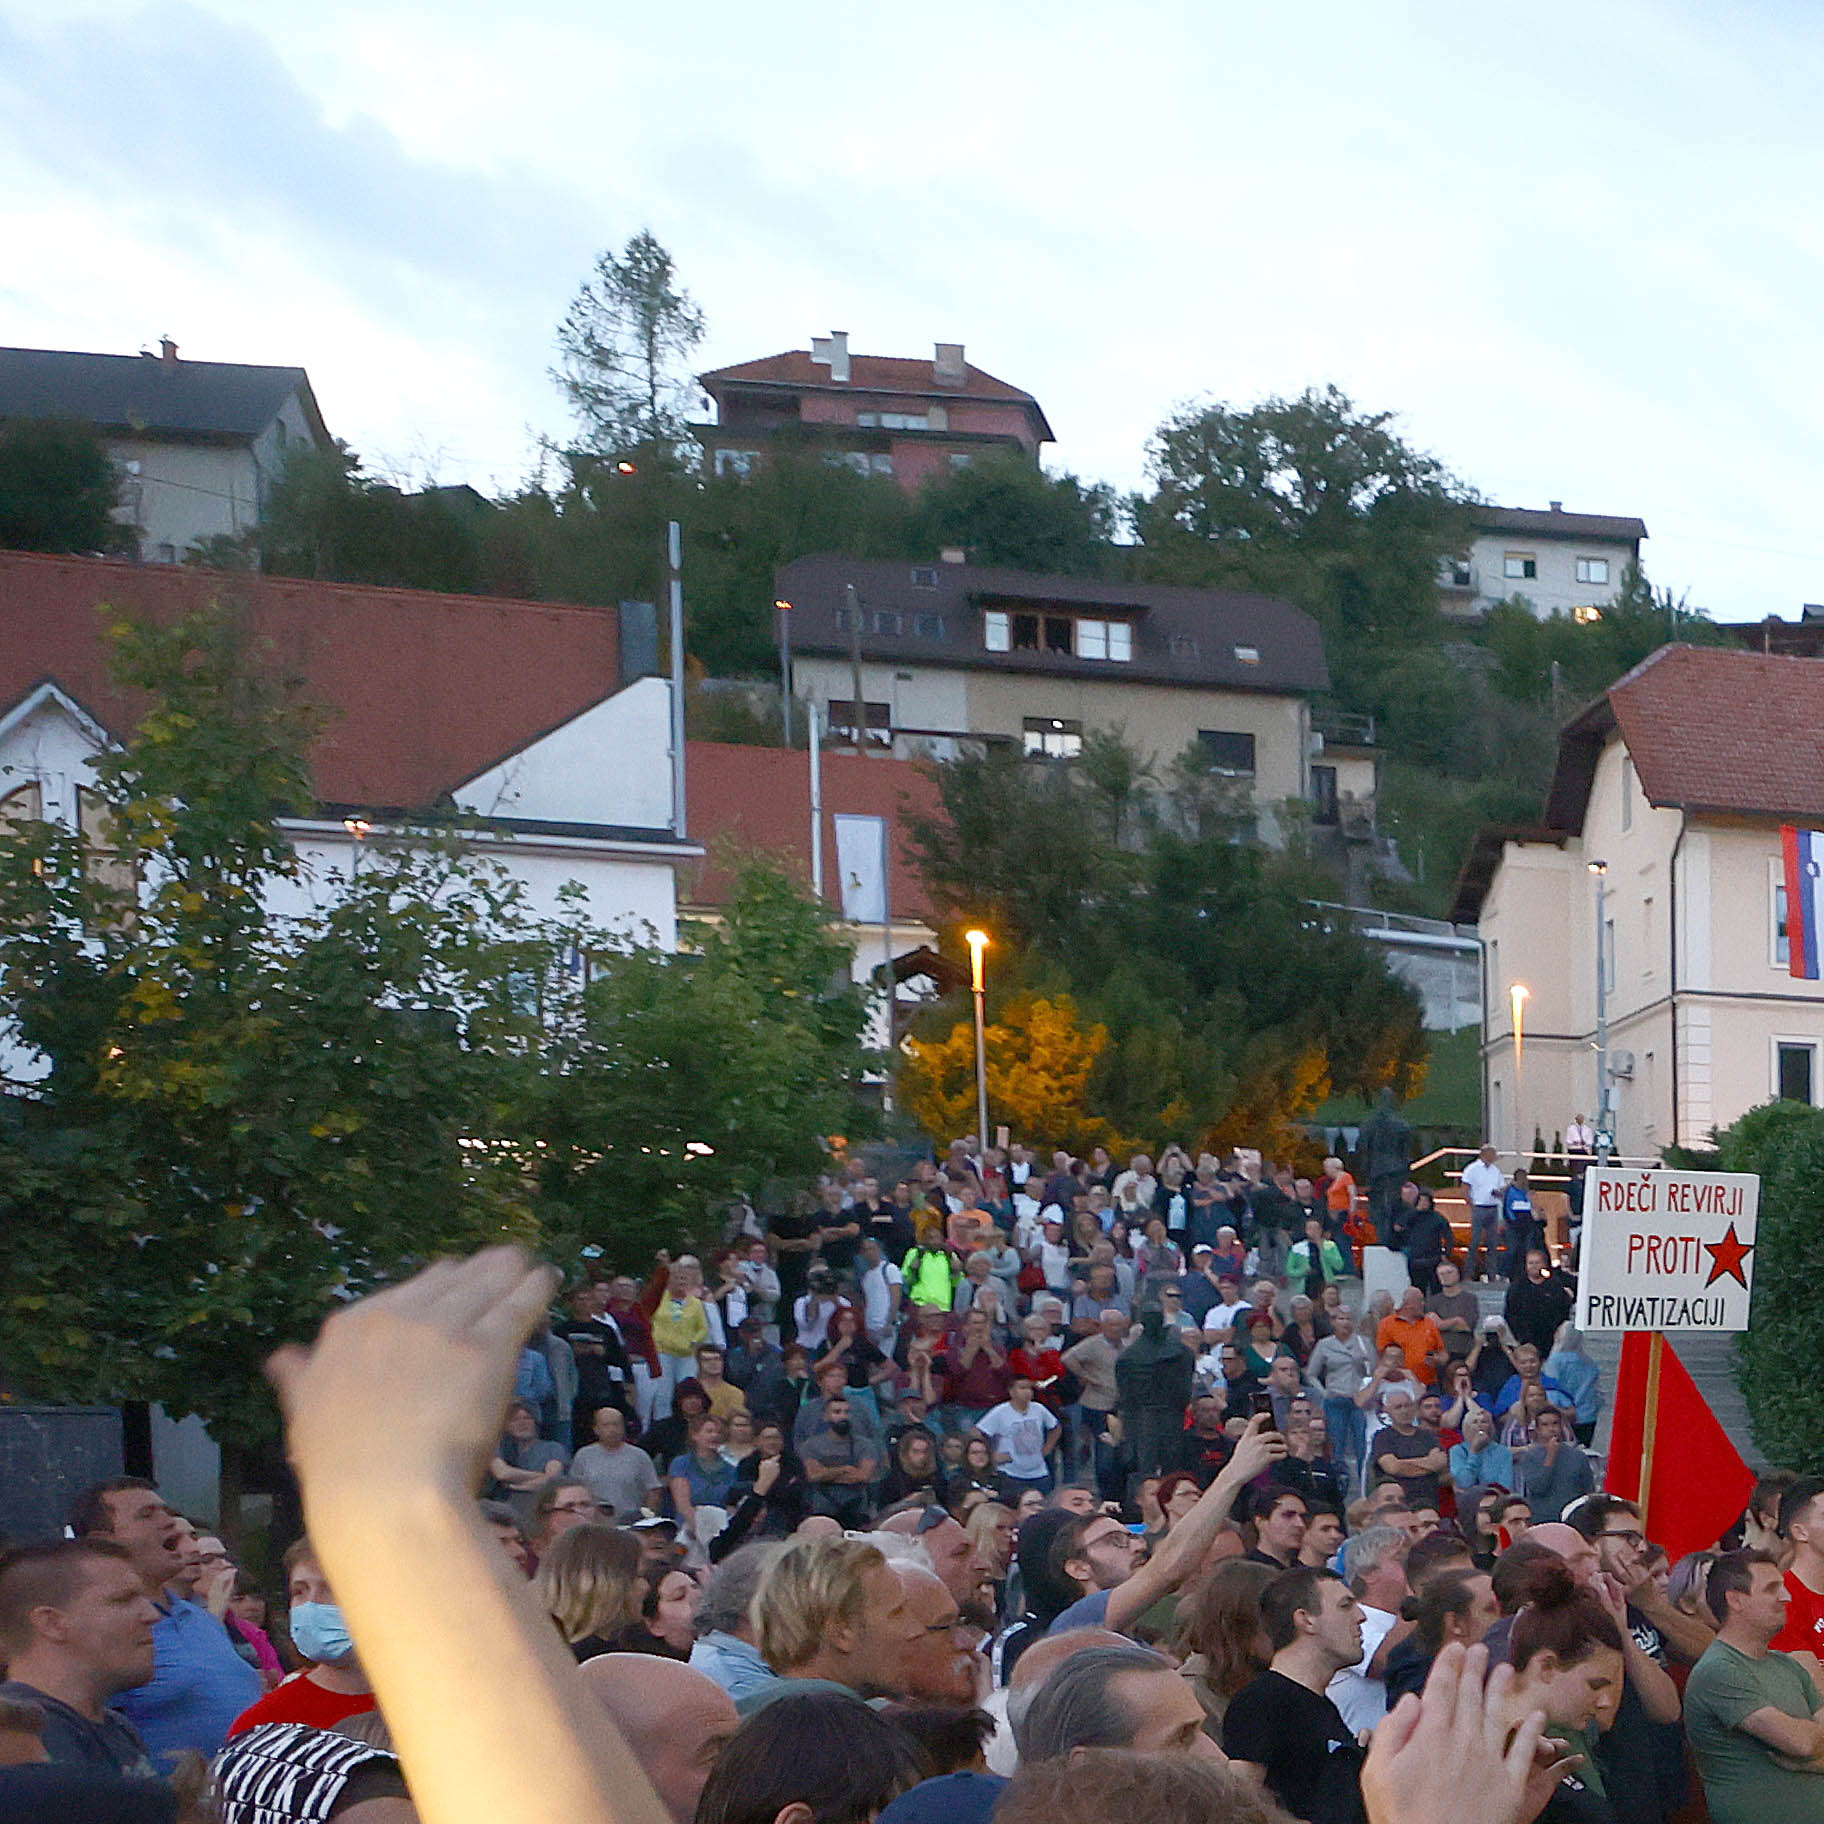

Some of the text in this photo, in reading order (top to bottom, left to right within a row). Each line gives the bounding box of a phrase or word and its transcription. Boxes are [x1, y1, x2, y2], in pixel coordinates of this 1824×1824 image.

[1599, 1173, 1744, 1216] RDEČI REVIRJI
[1627, 1234, 1700, 1275] PROTI
[1587, 1295, 1725, 1326] PRIVATIZACIJI
